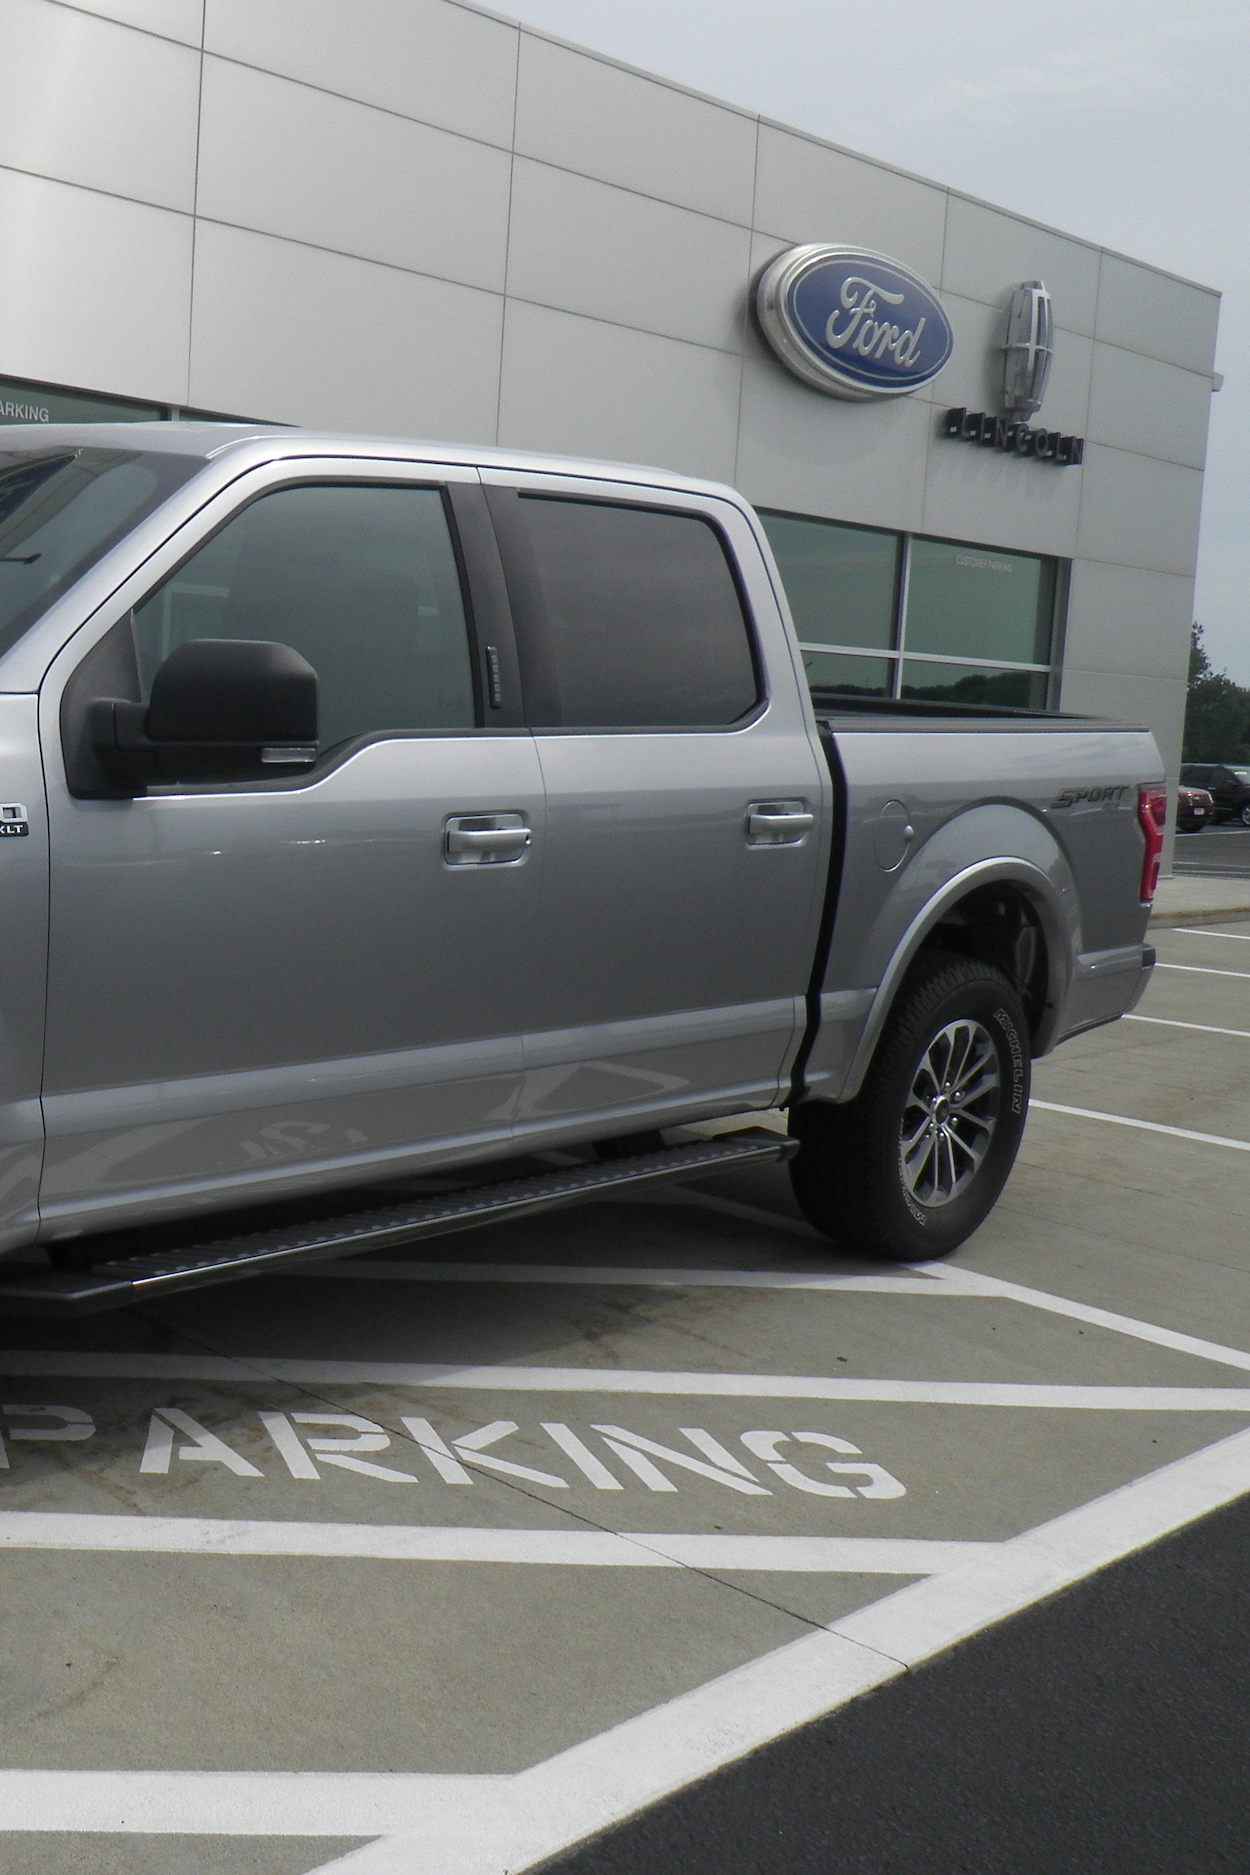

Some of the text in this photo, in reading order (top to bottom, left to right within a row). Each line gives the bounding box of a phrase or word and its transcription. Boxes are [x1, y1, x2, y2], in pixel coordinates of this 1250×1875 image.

[826, 276, 926, 368] Ford
[957, 407, 1084, 465] LINCOLN
[1050, 786, 1131, 809] SPORT
[993, 1008, 1024, 1115] MICHELIN
